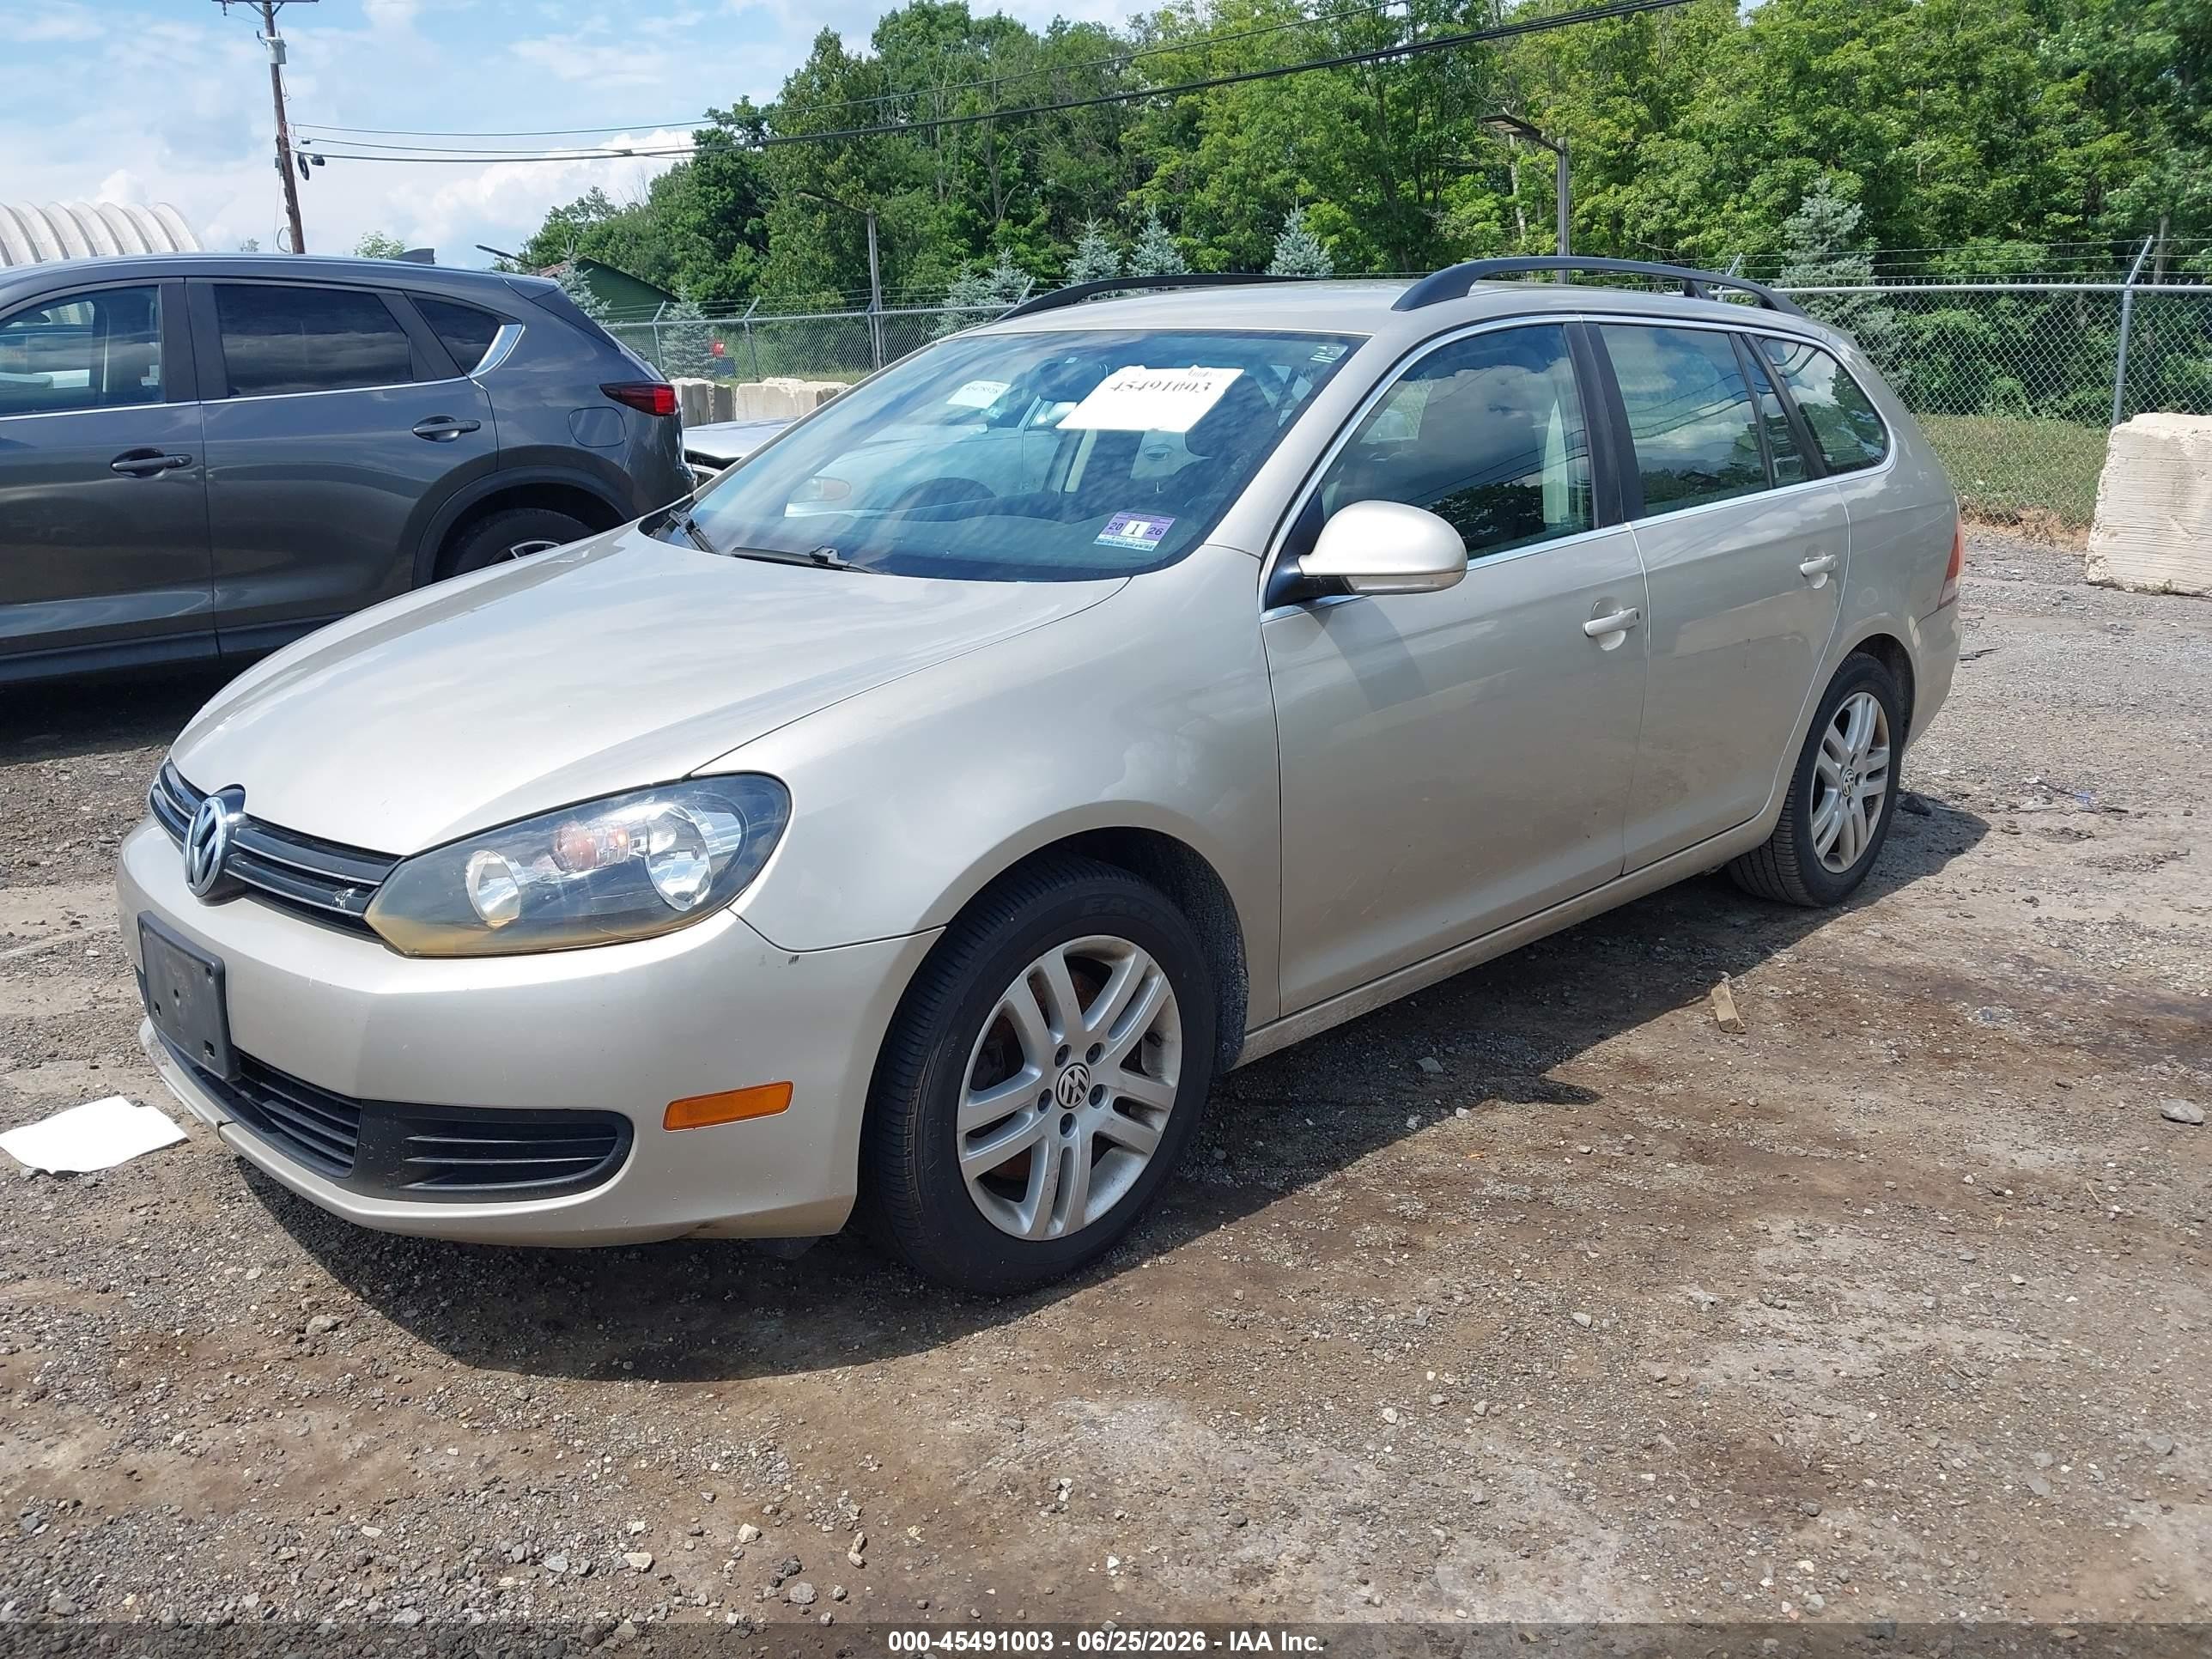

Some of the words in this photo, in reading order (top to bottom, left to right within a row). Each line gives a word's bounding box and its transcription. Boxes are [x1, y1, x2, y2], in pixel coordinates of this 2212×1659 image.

[1108, 521, 1124, 531] 20
[1129, 523, 1140, 536] 1
[1147, 526, 1164, 536] 26
